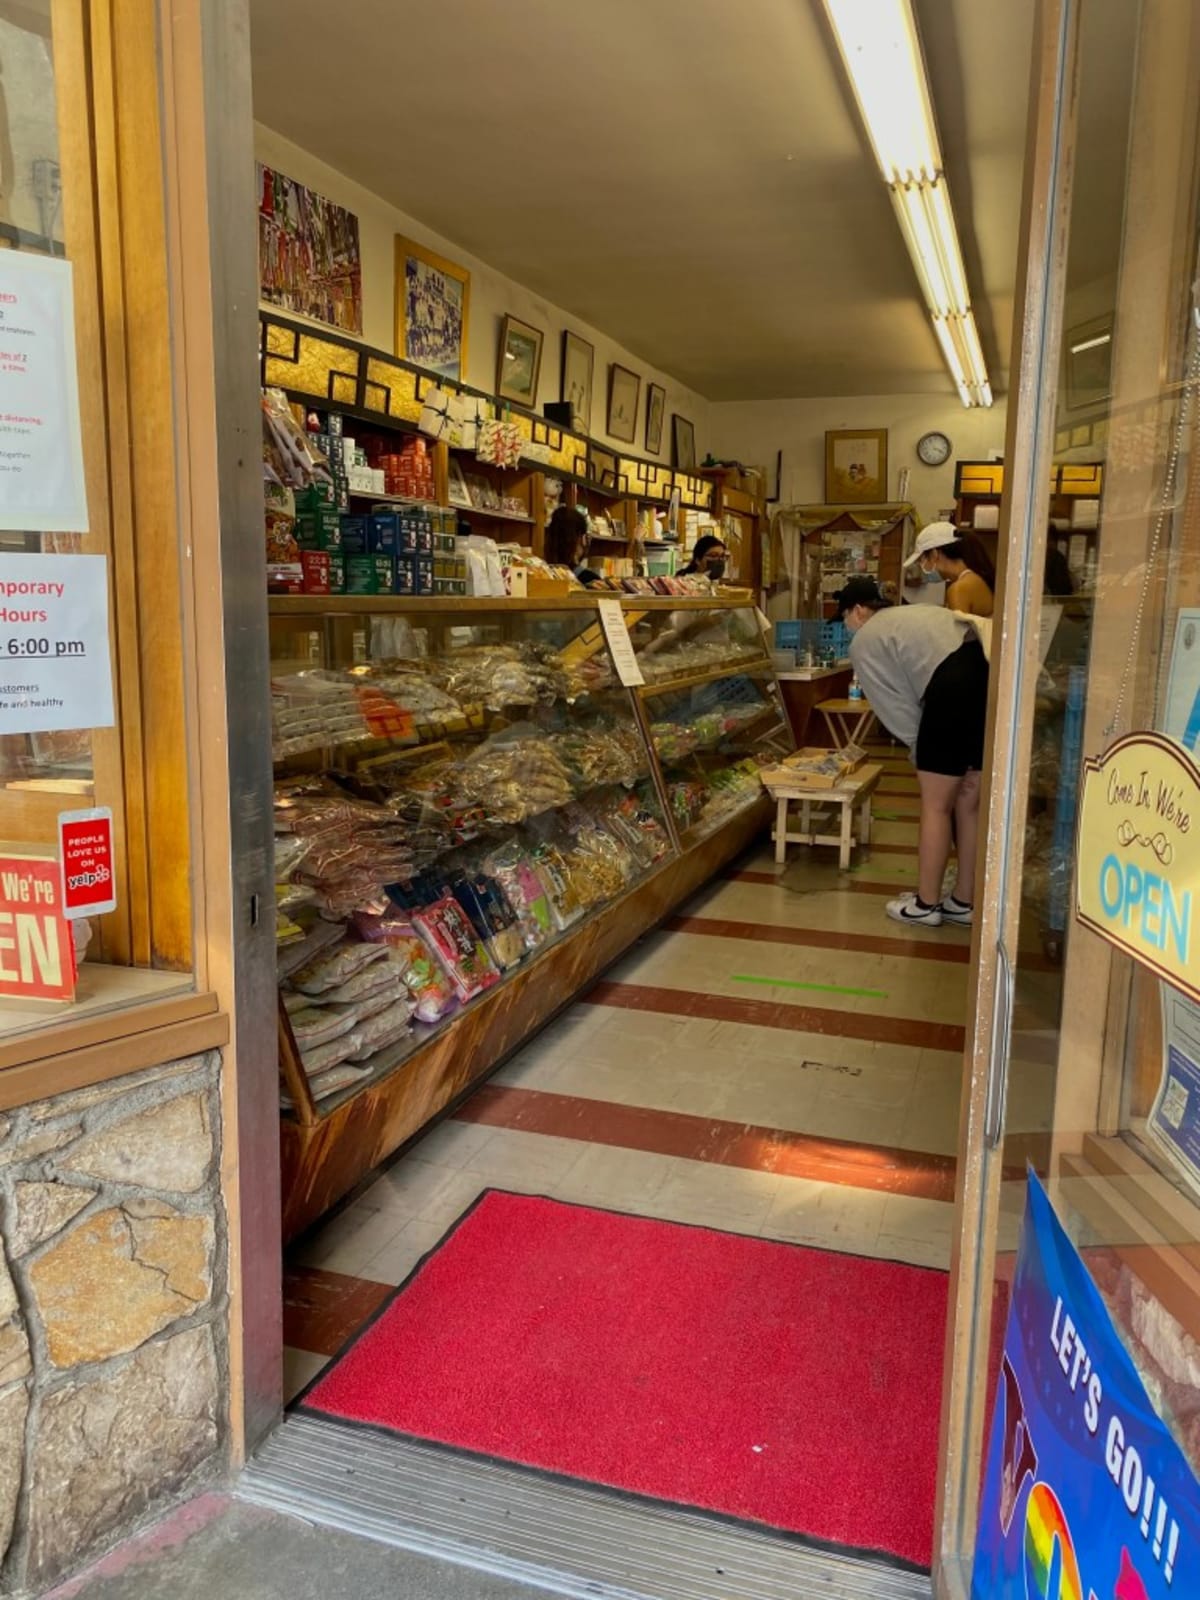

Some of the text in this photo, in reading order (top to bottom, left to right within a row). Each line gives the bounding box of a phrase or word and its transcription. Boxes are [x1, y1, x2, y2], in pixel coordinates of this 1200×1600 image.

[8, 638, 85, 656] 6:00 pm
[30, 698, 63, 708] healthy
[68, 835, 104, 846] PEOPLE
[67, 846, 107, 858] LOVE US
[80, 859, 95, 867] ON
[2, 872, 54, 904] We're
[69, 873, 97, 888] yelp
[1099, 853, 1191, 966] OPEN
[1050, 1296, 1179, 1584] LET'S GO!!!
